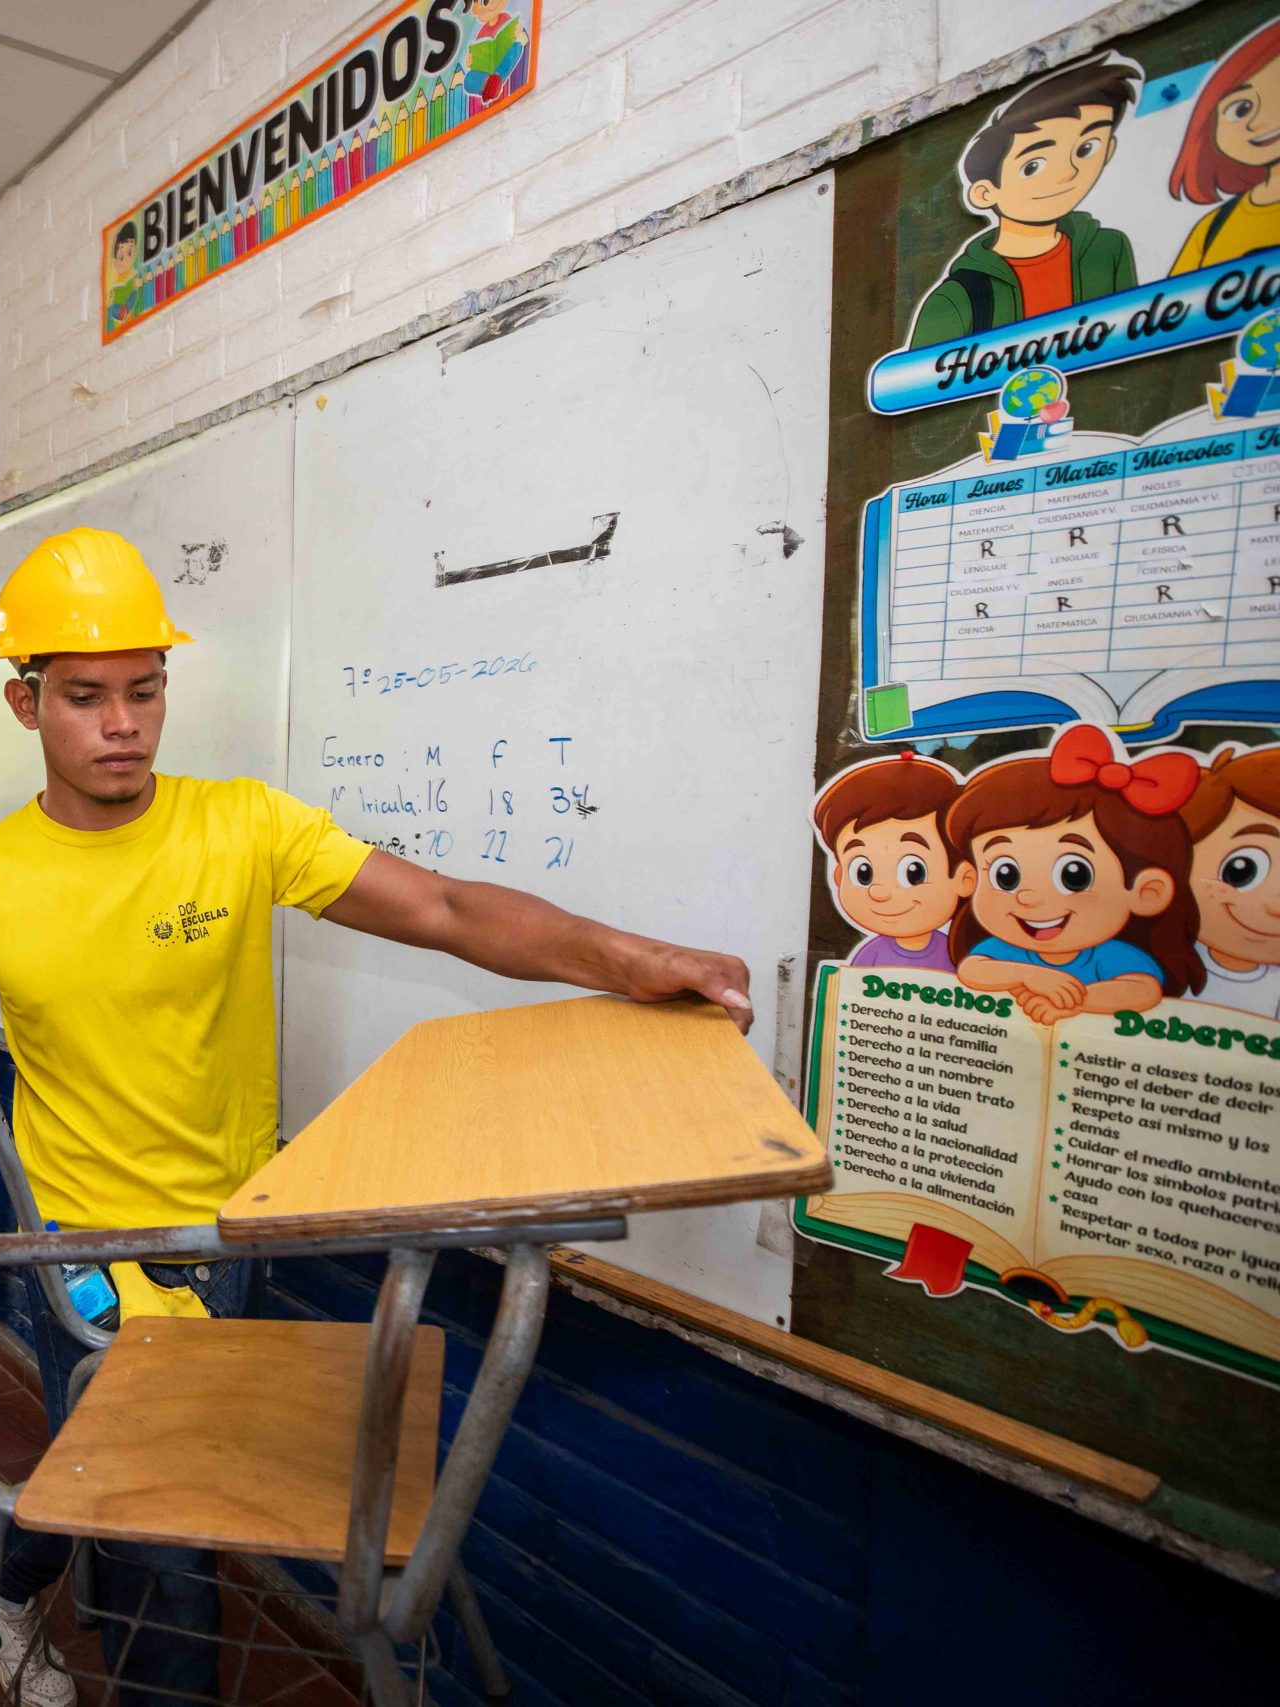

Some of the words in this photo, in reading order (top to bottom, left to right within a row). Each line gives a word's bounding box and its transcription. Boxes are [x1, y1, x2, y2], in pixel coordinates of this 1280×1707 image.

[142, 0, 461, 264] BIENVENIDOS
[935, 316, 1116, 390] Horario
[1127, 293, 1191, 340] de
[905, 492, 950, 510] Hora
[967, 479, 1024, 498] Lunes
[1045, 461, 1118, 486] Martes
[1133, 440, 1235, 471] Miércoles
[1142, 480, 1181, 492] INGLES
[969, 504, 1006, 516] CIENCIA
[1162, 515, 1185, 536] R
[980, 540, 996, 558] R
[1068, 527, 1088, 547] R
[964, 564, 1008, 574] LENGUAJE
[1050, 552, 1100, 564] LENGUAJE
[1048, 577, 1083, 587] INGLES
[1156, 585, 1174, 603] R
[975, 603, 989, 618] R
[1056, 597, 1072, 612] R
[958, 626, 994, 635] CIENCIA
[492, 740, 507, 768] F
[549, 737, 572, 765] T
[490, 789, 513, 815] 18
[178, 901, 197, 916] DOS
[182, 907, 229, 928] ESCUELAS
[862, 975, 1014, 1018] Derechos
[850, 1004, 903, 1021] Derecho
[908, 1013, 916, 1023] a
[921, 1014, 932, 1026] la
[937, 1018, 1008, 1038] educación
[850, 1019, 903, 1037] Derecho
[908, 1030, 915, 1039] a
[920, 1033, 944, 1045] una
[949, 1035, 997, 1054] familia
[848, 1051, 902, 1069] Derecho
[906, 1063, 914, 1072] a
[919, 1065, 934, 1076] un
[939, 1068, 994, 1088] nombre
[849, 1035, 903, 1053] Derecho
[907, 1046, 914, 1055] a
[919, 1046, 931, 1059] la
[936, 1052, 1013, 1074] recreación
[848, 1067, 901, 1085] Derecho
[906, 1079, 913, 1088] a
[918, 1081, 934, 1092] un
[939, 1084, 971, 1100] buen
[976, 1092, 1014, 1109] trato
[1074, 1052, 1126, 1070] Asistir
[1131, 1062, 1141, 1073] a
[1147, 1064, 1198, 1082] clases
[1204, 1072, 1252, 1093] todos
[1259, 1082, 1280, 1098] los
[1074, 1068, 1120, 1088] Tengo
[1125, 1076, 1138, 1090] el
[1144, 1080, 1193, 1100] deber
[1199, 1090, 1220, 1105] de
[1225, 1095, 1274, 1114] decir
[847, 1098, 900, 1118] Derecho
[904, 1111, 912, 1121] a
[916, 1112, 927, 1125] la
[932, 1117, 967, 1134] salud
[848, 1082, 900, 1101] Derecho
[905, 1094, 912, 1104] a
[917, 1095, 929, 1108] la
[933, 1100, 961, 1115] vida
[1073, 1086, 1136, 1108] siempre
[1141, 1098, 1155, 1111] la
[1161, 1102, 1221, 1124] verdad
[846, 1114, 898, 1133] Derecho
[903, 1127, 911, 1136] a
[915, 1128, 926, 1141] la
[931, 1132, 1018, 1164] nacionalidad
[1070, 1120, 1120, 1139] demás
[1072, 1102, 1133, 1126] Respeto
[1139, 1116, 1162, 1131] así
[1167, 1122, 1223, 1144] mismo
[1229, 1137, 1239, 1150] y
[1246, 1137, 1270, 1153] los
[844, 1145, 896, 1166] Derecho
[901, 1159, 908, 1169] a
[913, 1163, 936, 1177] una
[941, 1169, 995, 1193] vivienda
[845, 1129, 897, 1150] Derecho
[902, 1143, 909, 1153] a
[913, 1144, 925, 1157] la
[929, 1150, 1003, 1178] protección
[1068, 1137, 1120, 1156] Cuidar
[1124, 1149, 1138, 1162] el
[1144, 1154, 1192, 1174] medio
[1198, 1166, 1280, 1194] ambiente
[843, 1160, 895, 1182] Derecho
[900, 1176, 907, 1186] a
[912, 1178, 922, 1190] la
[927, 1184, 1015, 1216] alimentación
[1062, 1188, 1098, 1206] casa
[1064, 1171, 1112, 1191] Ayudo
[1118, 1184, 1146, 1200] con
[1152, 1191, 1174, 1207] los
[1066, 1154, 1122, 1175] Honrar
[1127, 1166, 1148, 1182] los
[1154, 1172, 1226, 1200] símbolos
[1232, 1197, 1280, 1214] patri
[1062, 1204, 1132, 1231] Respetar
[1138, 1224, 1148, 1236] a
[1154, 1228, 1199, 1250] todos
[1204, 1242, 1236, 1260] por
[1060, 1220, 1131, 1249] importar
[1183, 1255, 1224, 1276] raza
[1230, 1268, 1240, 1280] o
[1246, 1272, 1280, 1296] reli
